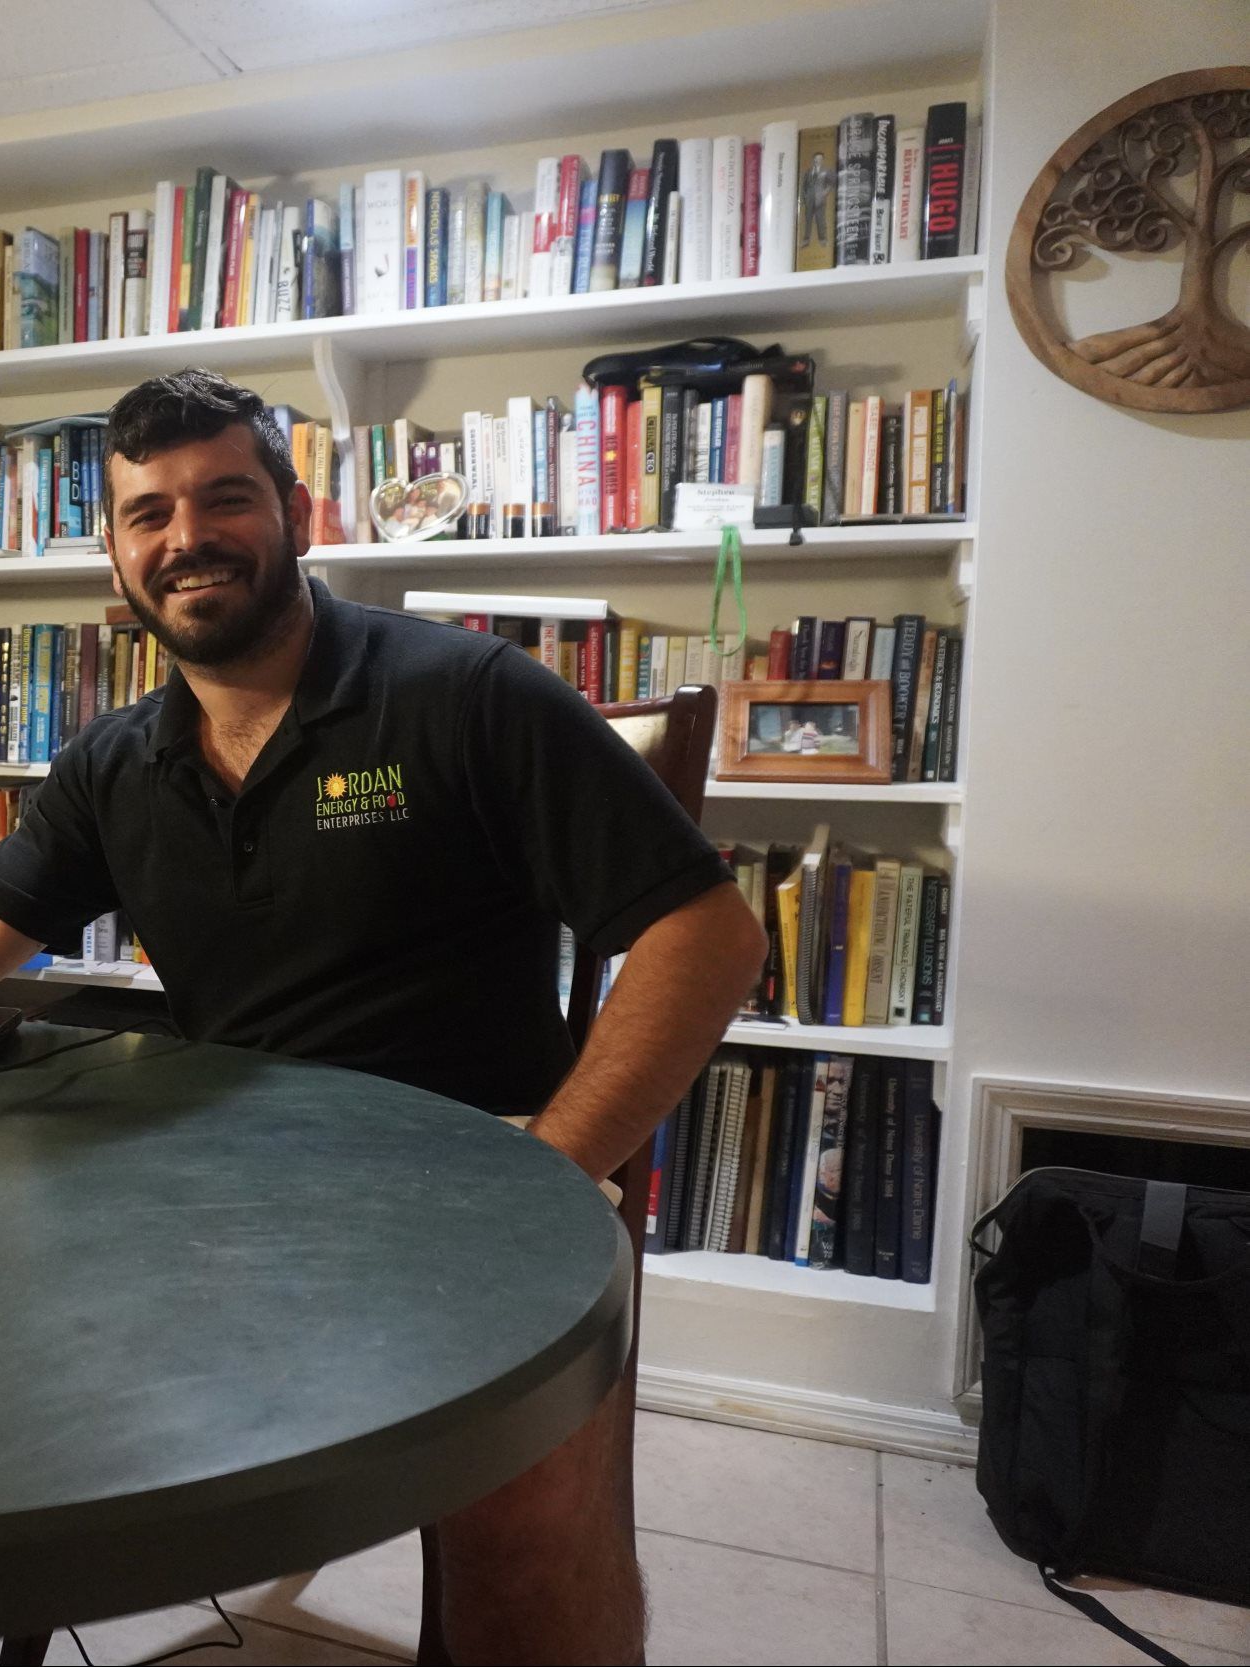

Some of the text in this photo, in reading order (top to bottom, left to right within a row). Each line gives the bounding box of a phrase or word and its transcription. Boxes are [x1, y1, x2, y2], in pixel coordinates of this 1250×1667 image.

[726, 138, 736, 215] CONDOLEEZZA
[877, 119, 890, 194] INCOMPARABLE
[846, 119, 861, 242] BRUCE SPRINGSTEEN
[900, 148, 913, 241] REVOLUTIONARY
[929, 163, 960, 233] HUGO
[366, 198, 399, 209] WORLD
[428, 191, 441, 284] NICHOLAS SPARKS
[468, 246, 481, 279] SPARKS
[277, 280, 292, 314] BUZZ
[832, 395, 841, 416] DEEP
[645, 416, 656, 473] CHINA CEO
[831, 418, 840, 444] DOWN
[315, 432, 326, 493] THINGS FALL APART
[578, 420, 596, 488] CHINA
[543, 624, 555, 669] THE INFINIT
[901, 620, 918, 658] TEDDY
[937, 636, 947, 647] ON
[20, 628, 32, 725] UNDER THE TARNISHED DOME
[935, 648, 946, 674] ETHICS
[894, 671, 912, 719] BOOKER
[931, 682, 942, 724] ECONOMICS
[316, 790, 405, 817] ENERGY & FOOD
[316, 807, 411, 831] ENTERPRISES LLC
[940, 887, 950, 914] CHOMSKY
[897, 877, 915, 1003] THE FATEFUL TRIANGLE CHOMSKY
[922, 879, 938, 986] NECESSARY ILLUSIONS
[856, 1073, 870, 1121] University
[885, 1076, 898, 1113] University
[885, 1128, 896, 1150] Notre
[886, 1116, 896, 1125] of
[854, 1142, 867, 1170] Notre
[884, 1153, 895, 1174] Dame
[911, 1113, 927, 1239] University of Notre Dame
